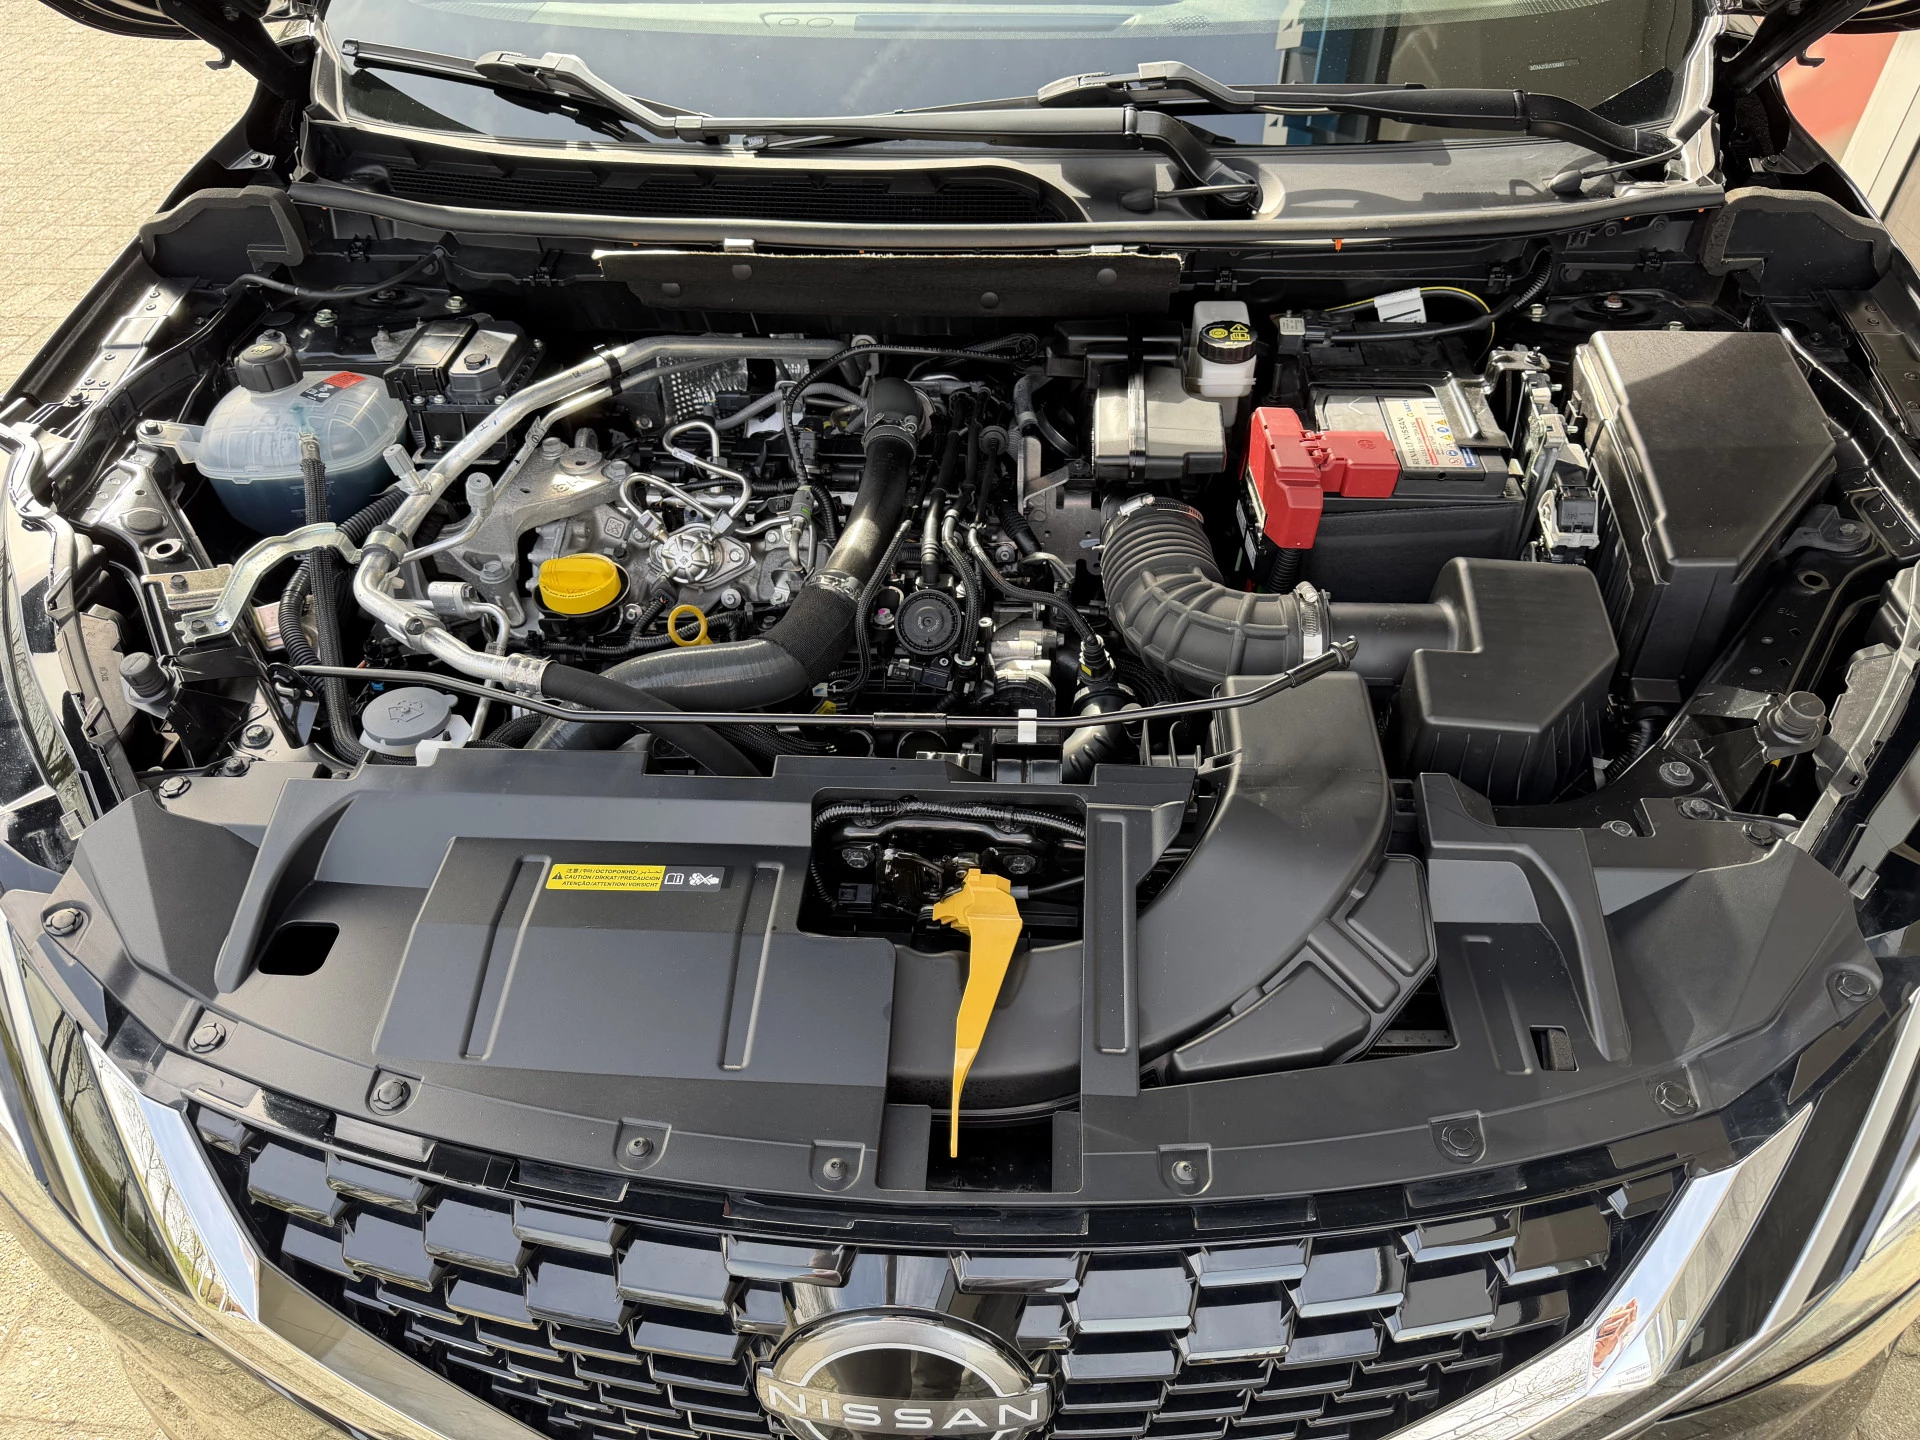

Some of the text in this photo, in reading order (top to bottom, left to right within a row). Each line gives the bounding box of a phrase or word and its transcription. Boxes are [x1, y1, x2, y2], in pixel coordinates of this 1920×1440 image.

[1397, 416, 1410, 440] NISSAN
[1405, 441, 1420, 465] RENAULT
[768, 1385, 1038, 1429] NISSAN
